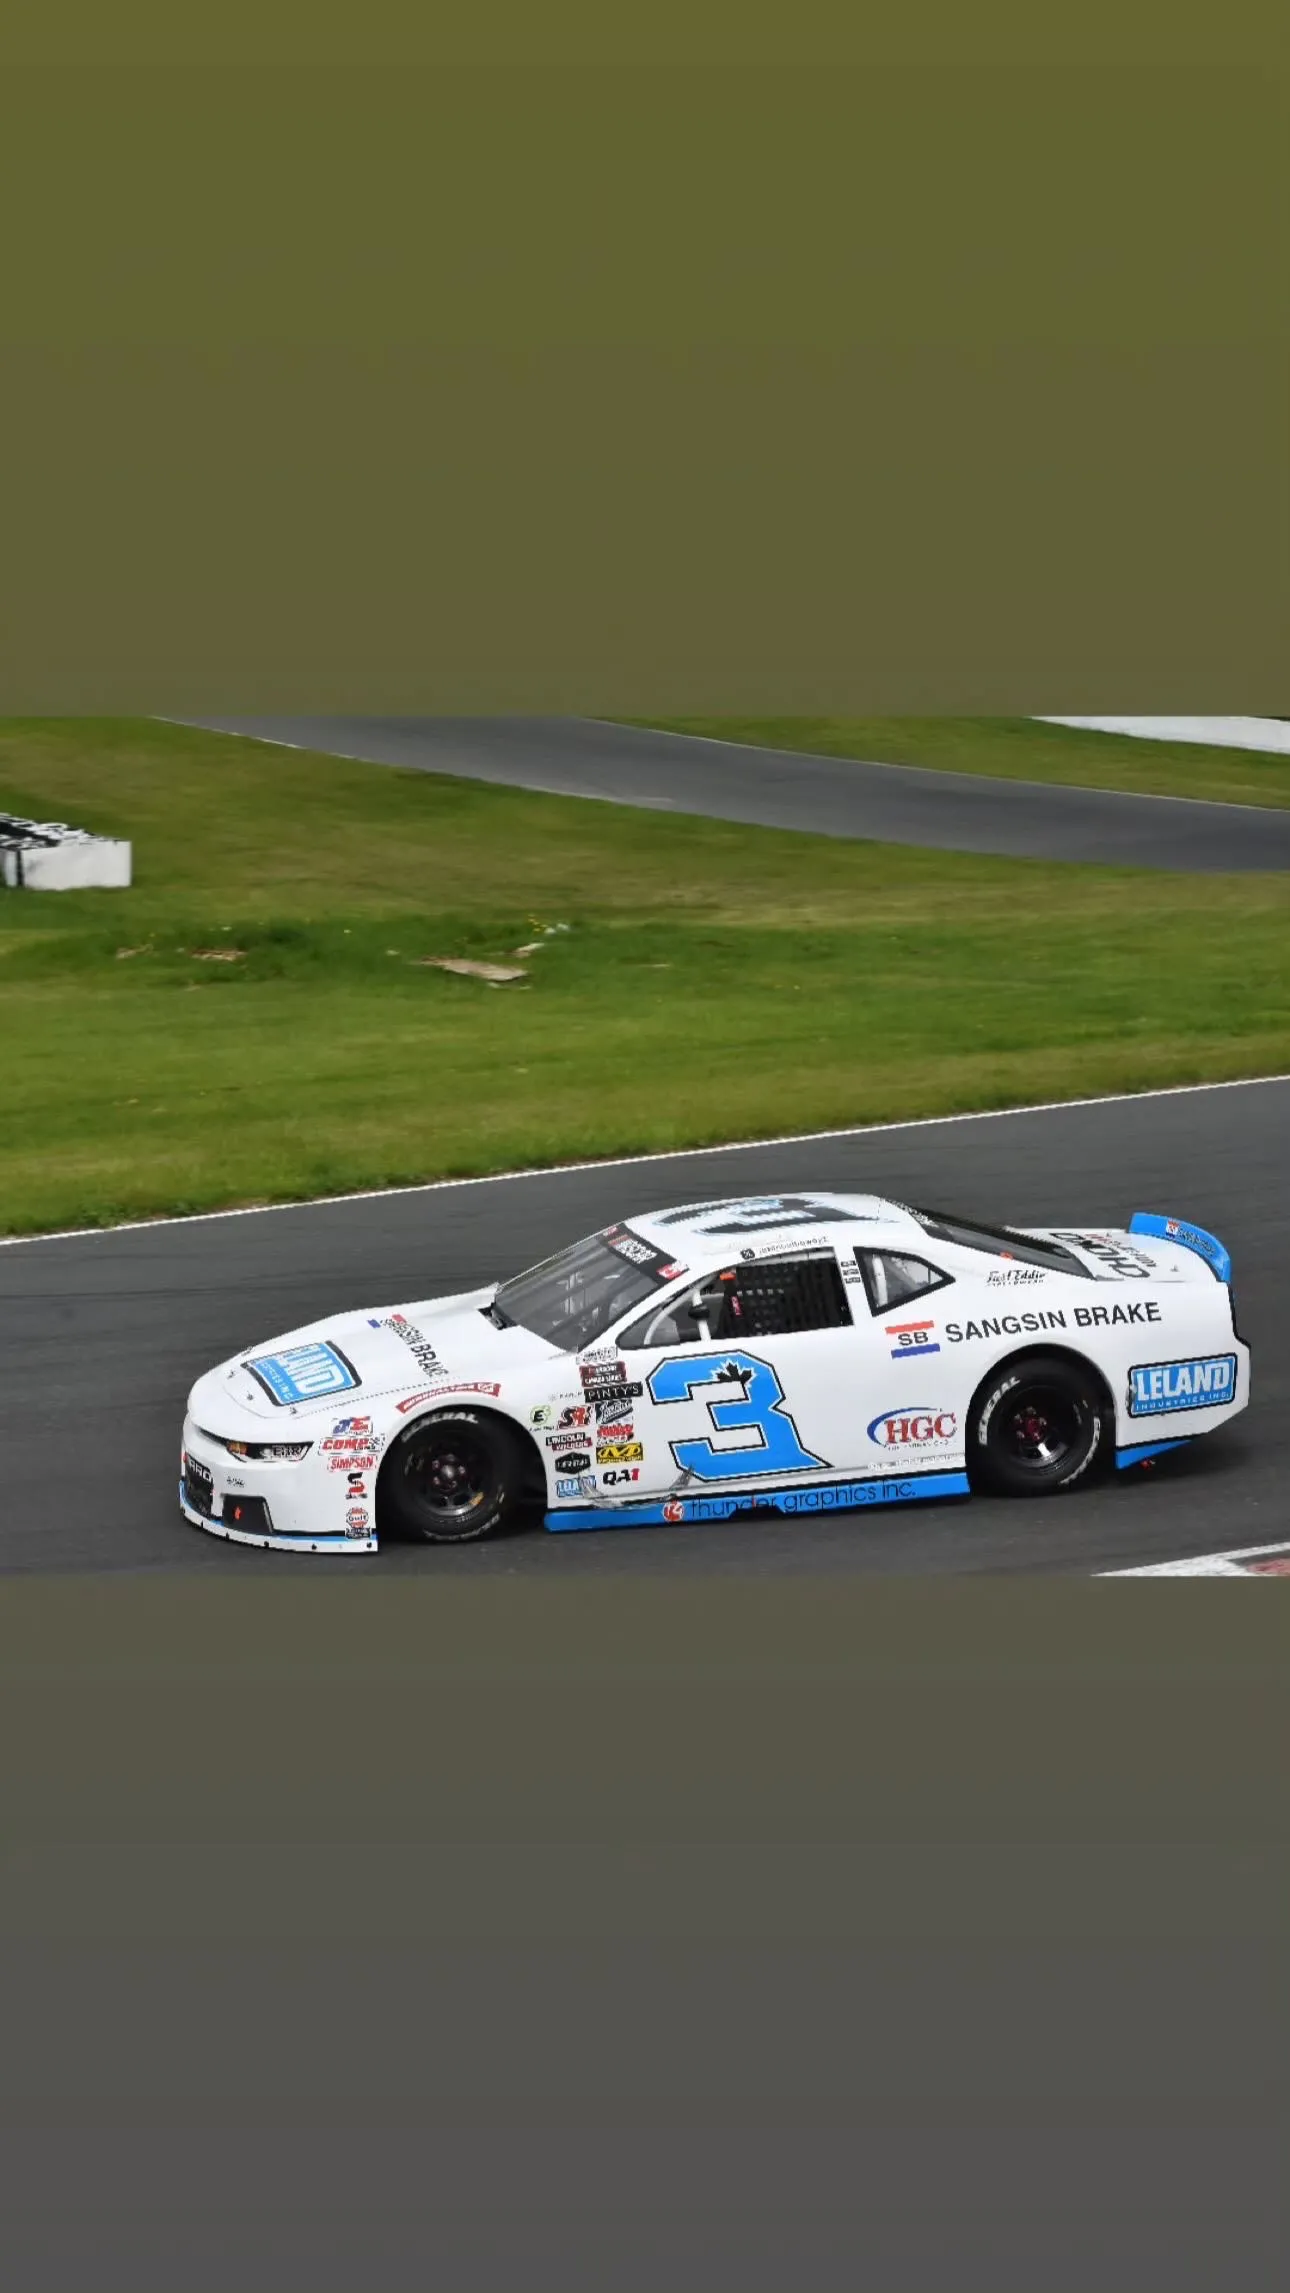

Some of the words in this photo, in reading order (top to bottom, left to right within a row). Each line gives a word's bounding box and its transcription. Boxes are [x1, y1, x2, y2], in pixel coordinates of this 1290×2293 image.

[945, 1310, 1067, 1343] SANGSIN
[1074, 1301, 1162, 1327] BRAKE
[897, 1331, 929, 1346] SB
[588, 1384, 640, 1400] PINTY'S
[1136, 1362, 1230, 1401] LELAND
[646, 1349, 833, 1483] 3
[884, 1412, 957, 1444] HGC
[547, 1433, 585, 1446] LINCOLN
[330, 1456, 374, 1470] SIMPSON
[603, 1468, 640, 1486] QA1
[783, 1482, 877, 1512] graphics
